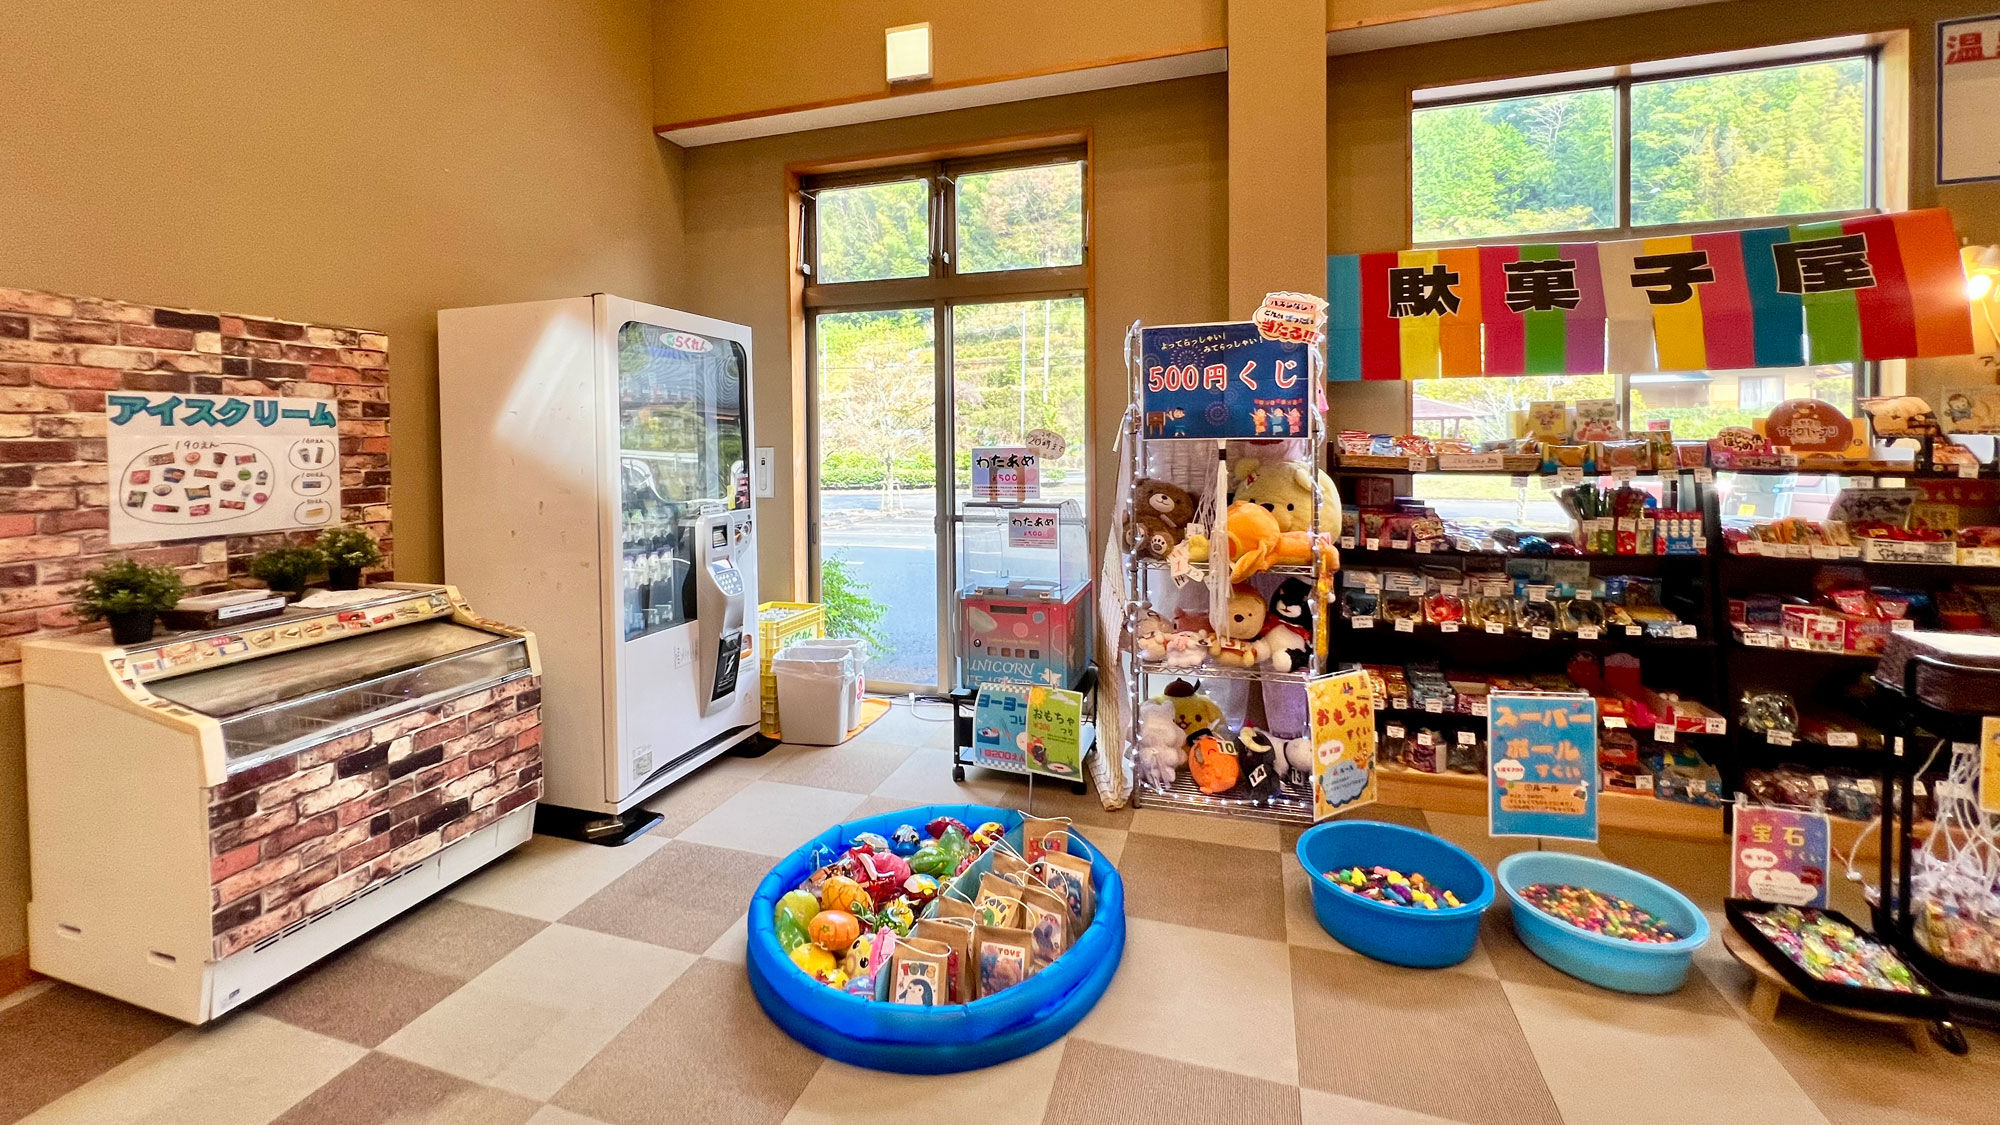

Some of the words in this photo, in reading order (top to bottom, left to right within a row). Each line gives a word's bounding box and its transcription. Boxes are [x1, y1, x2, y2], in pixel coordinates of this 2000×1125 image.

[1945, 31, 2000, 65] 温
[1387, 233, 1876, 319] 駄菓子屋
[1149, 360, 1297, 392] 500円くじ
[108, 395, 336, 429] アイスクリーム
[976, 454, 1035, 469] わたあめ
[1012, 517, 1055, 528] わたあめ
[967, 659, 1036, 678] UNICORN
[1033, 708, 1075, 726] おもちゃ
[1317, 700, 1370, 727] おもちゃ
[1495, 706, 1592, 728] スーパー
[1217, 742, 1235, 753] 10
[1506, 738, 1581, 761] ボール
[1250, 768, 1265, 784] 14
[1535, 763, 1581, 778] すくい
[1751, 823, 1806, 847] 宝石
[998, 947, 1022, 958] TOYS
[901, 962, 936, 979] TOYS
